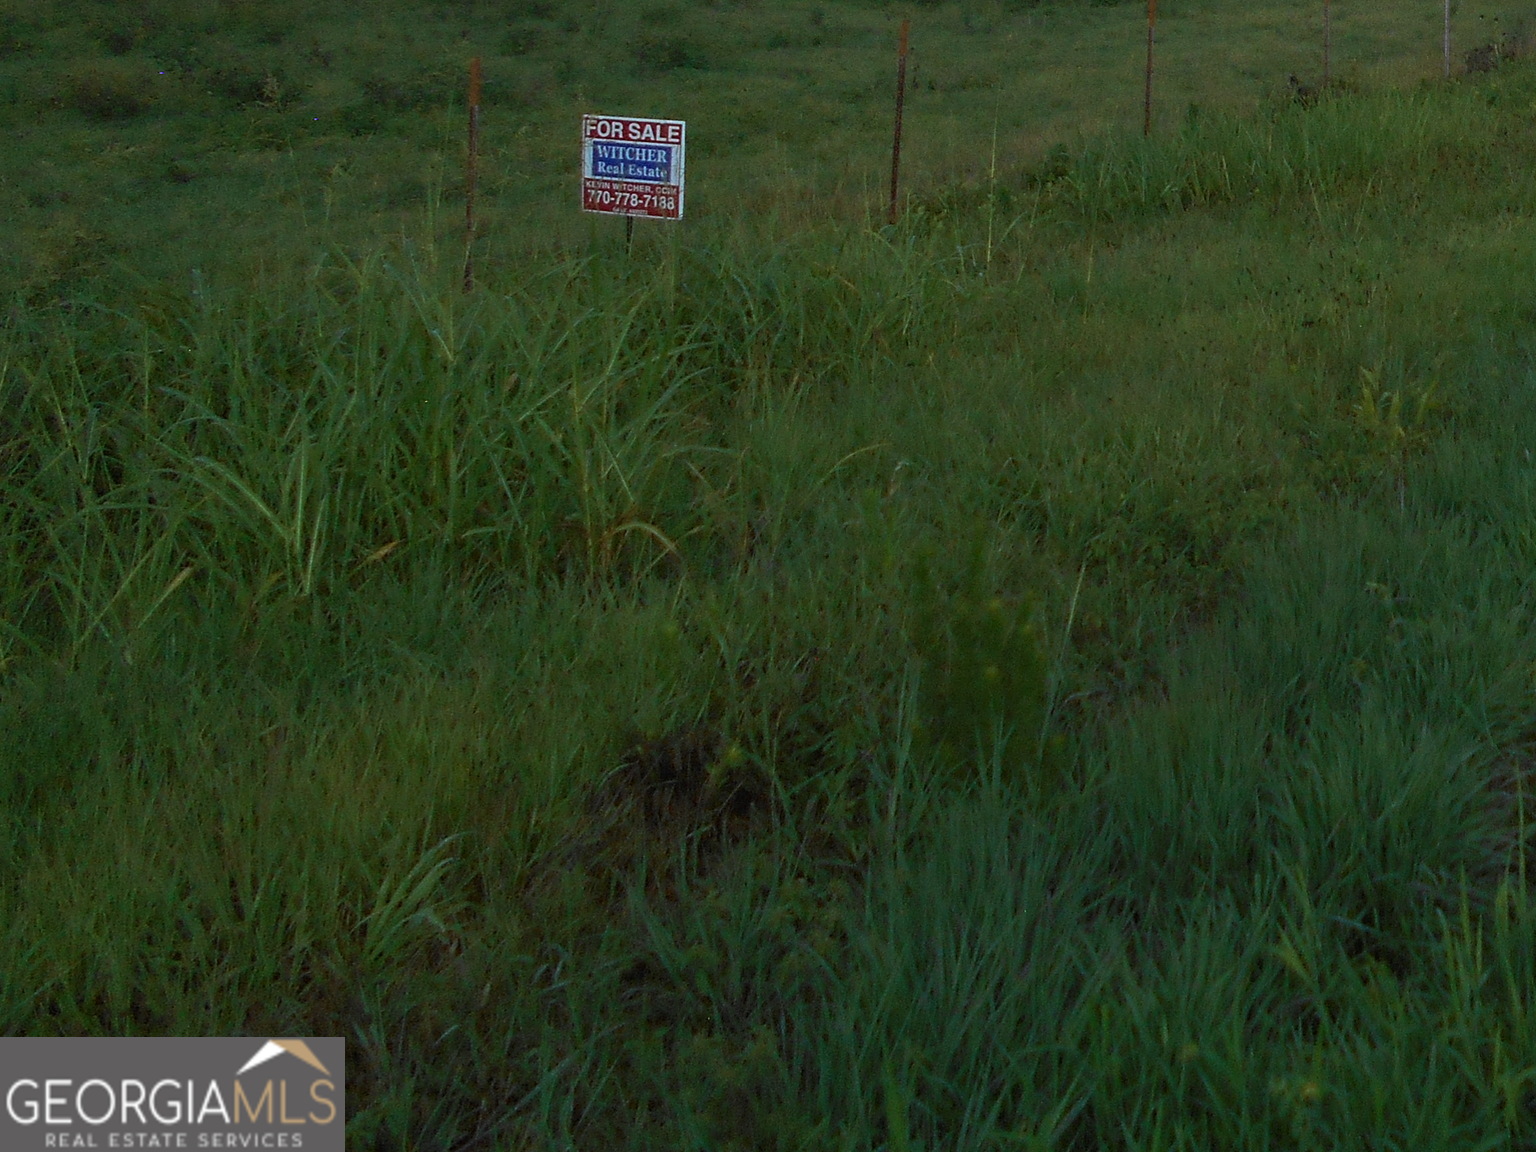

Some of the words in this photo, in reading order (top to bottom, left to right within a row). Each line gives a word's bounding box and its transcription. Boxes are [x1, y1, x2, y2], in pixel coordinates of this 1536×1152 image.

[586, 119, 624, 139] FOR
[628, 122, 681, 144] SALE
[597, 144, 667, 163] WITCHER
[597, 161, 624, 175] Real
[628, 164, 668, 178] Estate
[611, 182, 654, 194] WTCHER,
[587, 189, 676, 210] 770-778-7188
